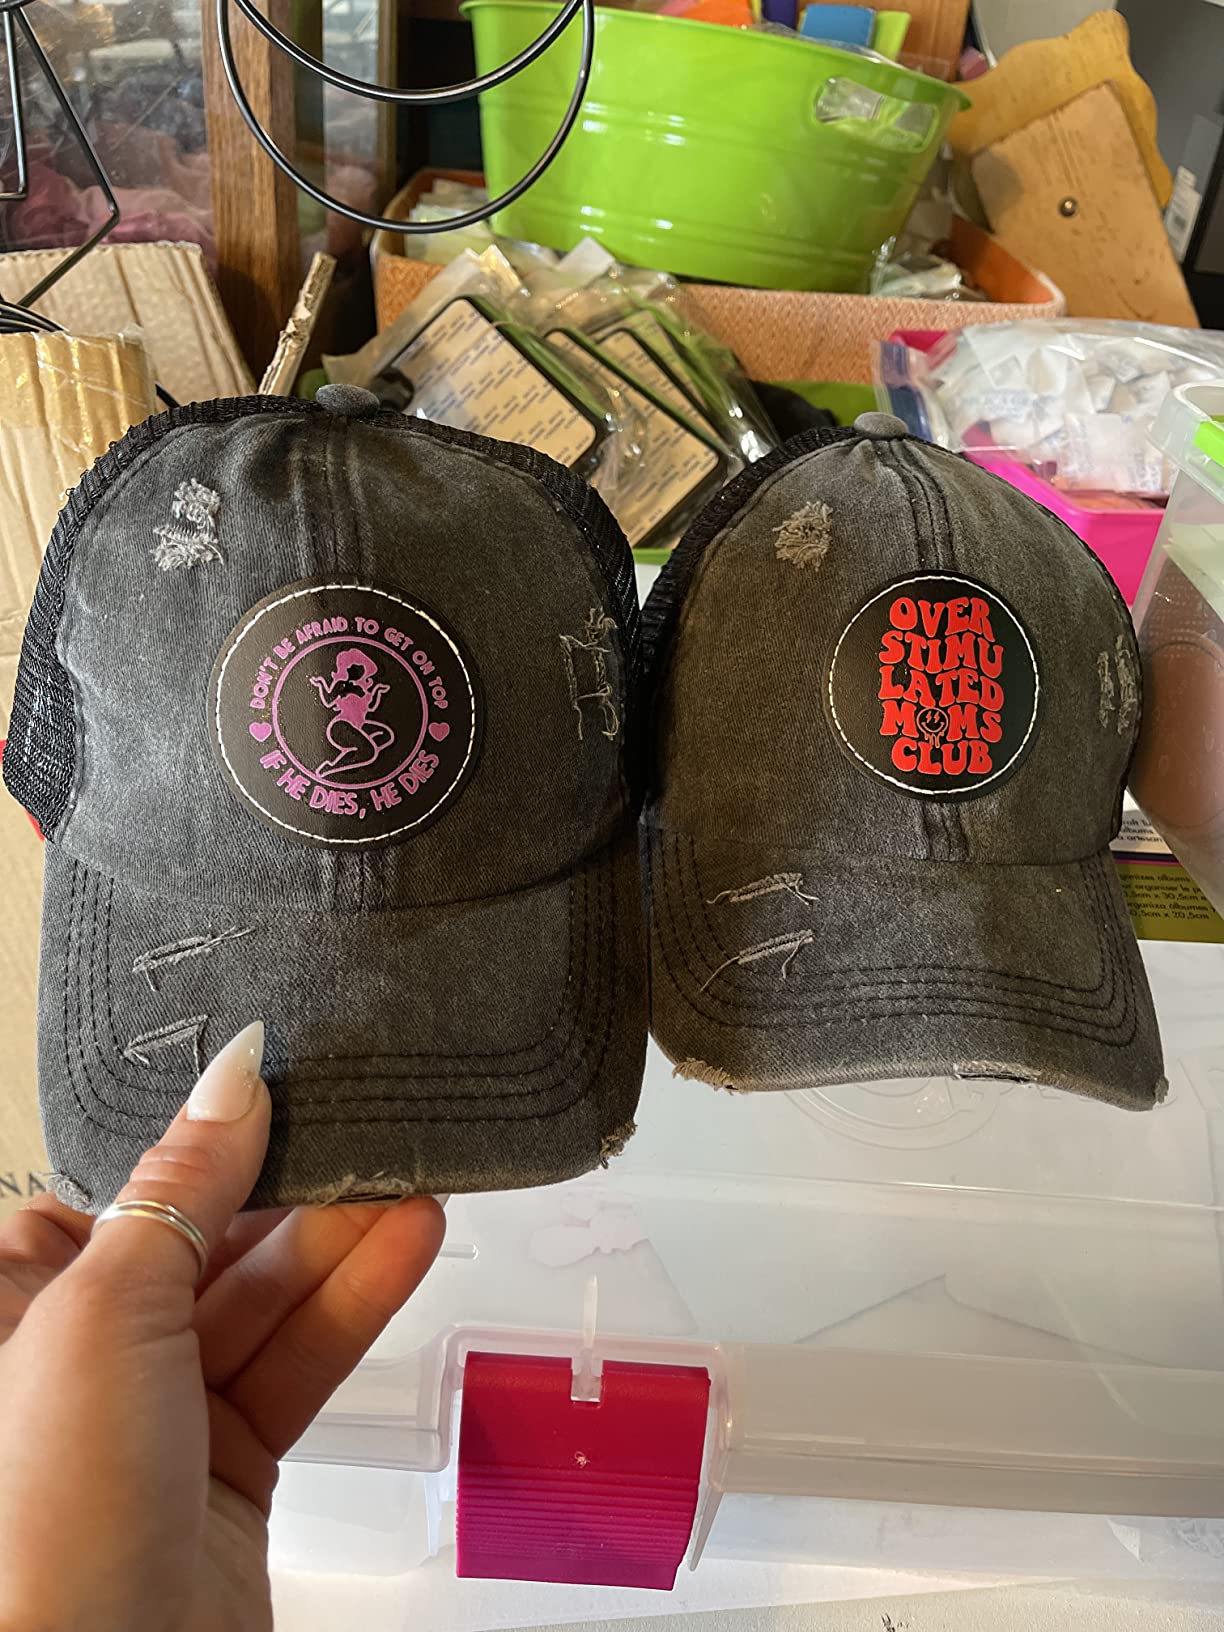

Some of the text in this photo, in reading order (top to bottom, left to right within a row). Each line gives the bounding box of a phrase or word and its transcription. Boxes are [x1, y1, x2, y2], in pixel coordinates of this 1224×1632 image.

[889, 596, 996, 642] OVER
[250, 616, 449, 709] DON'T BE AFRAID TO GET ON TOP
[878, 630, 1004, 678] STIMU
[877, 665, 1005, 712] LATED
[891, 737, 993, 775] CLUB
[259, 750, 440, 819] IF HE DIES, HE DIES
